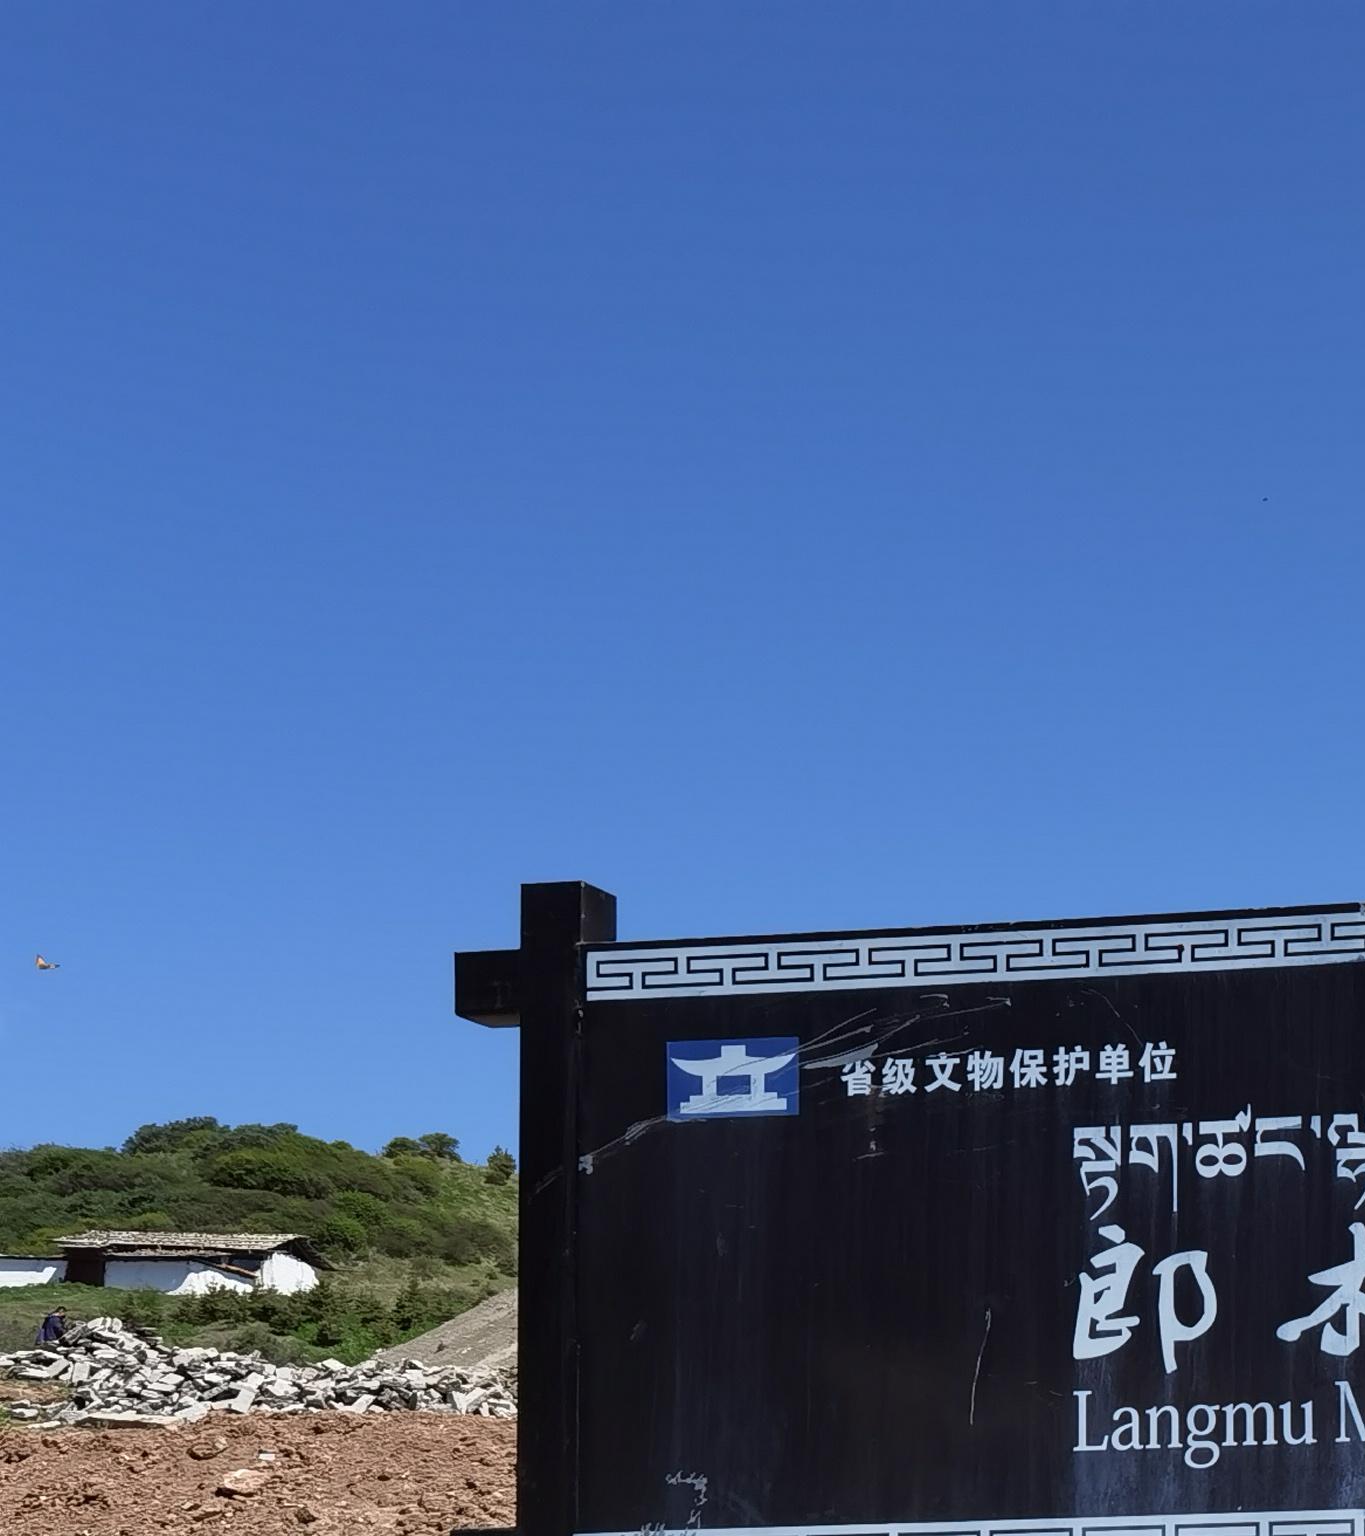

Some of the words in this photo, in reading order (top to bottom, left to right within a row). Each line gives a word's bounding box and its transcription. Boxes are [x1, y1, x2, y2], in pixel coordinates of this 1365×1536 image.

[841, 1040, 1178, 1097] 省级文物保护单位
[1073, 1390, 1317, 1469] Langmu
